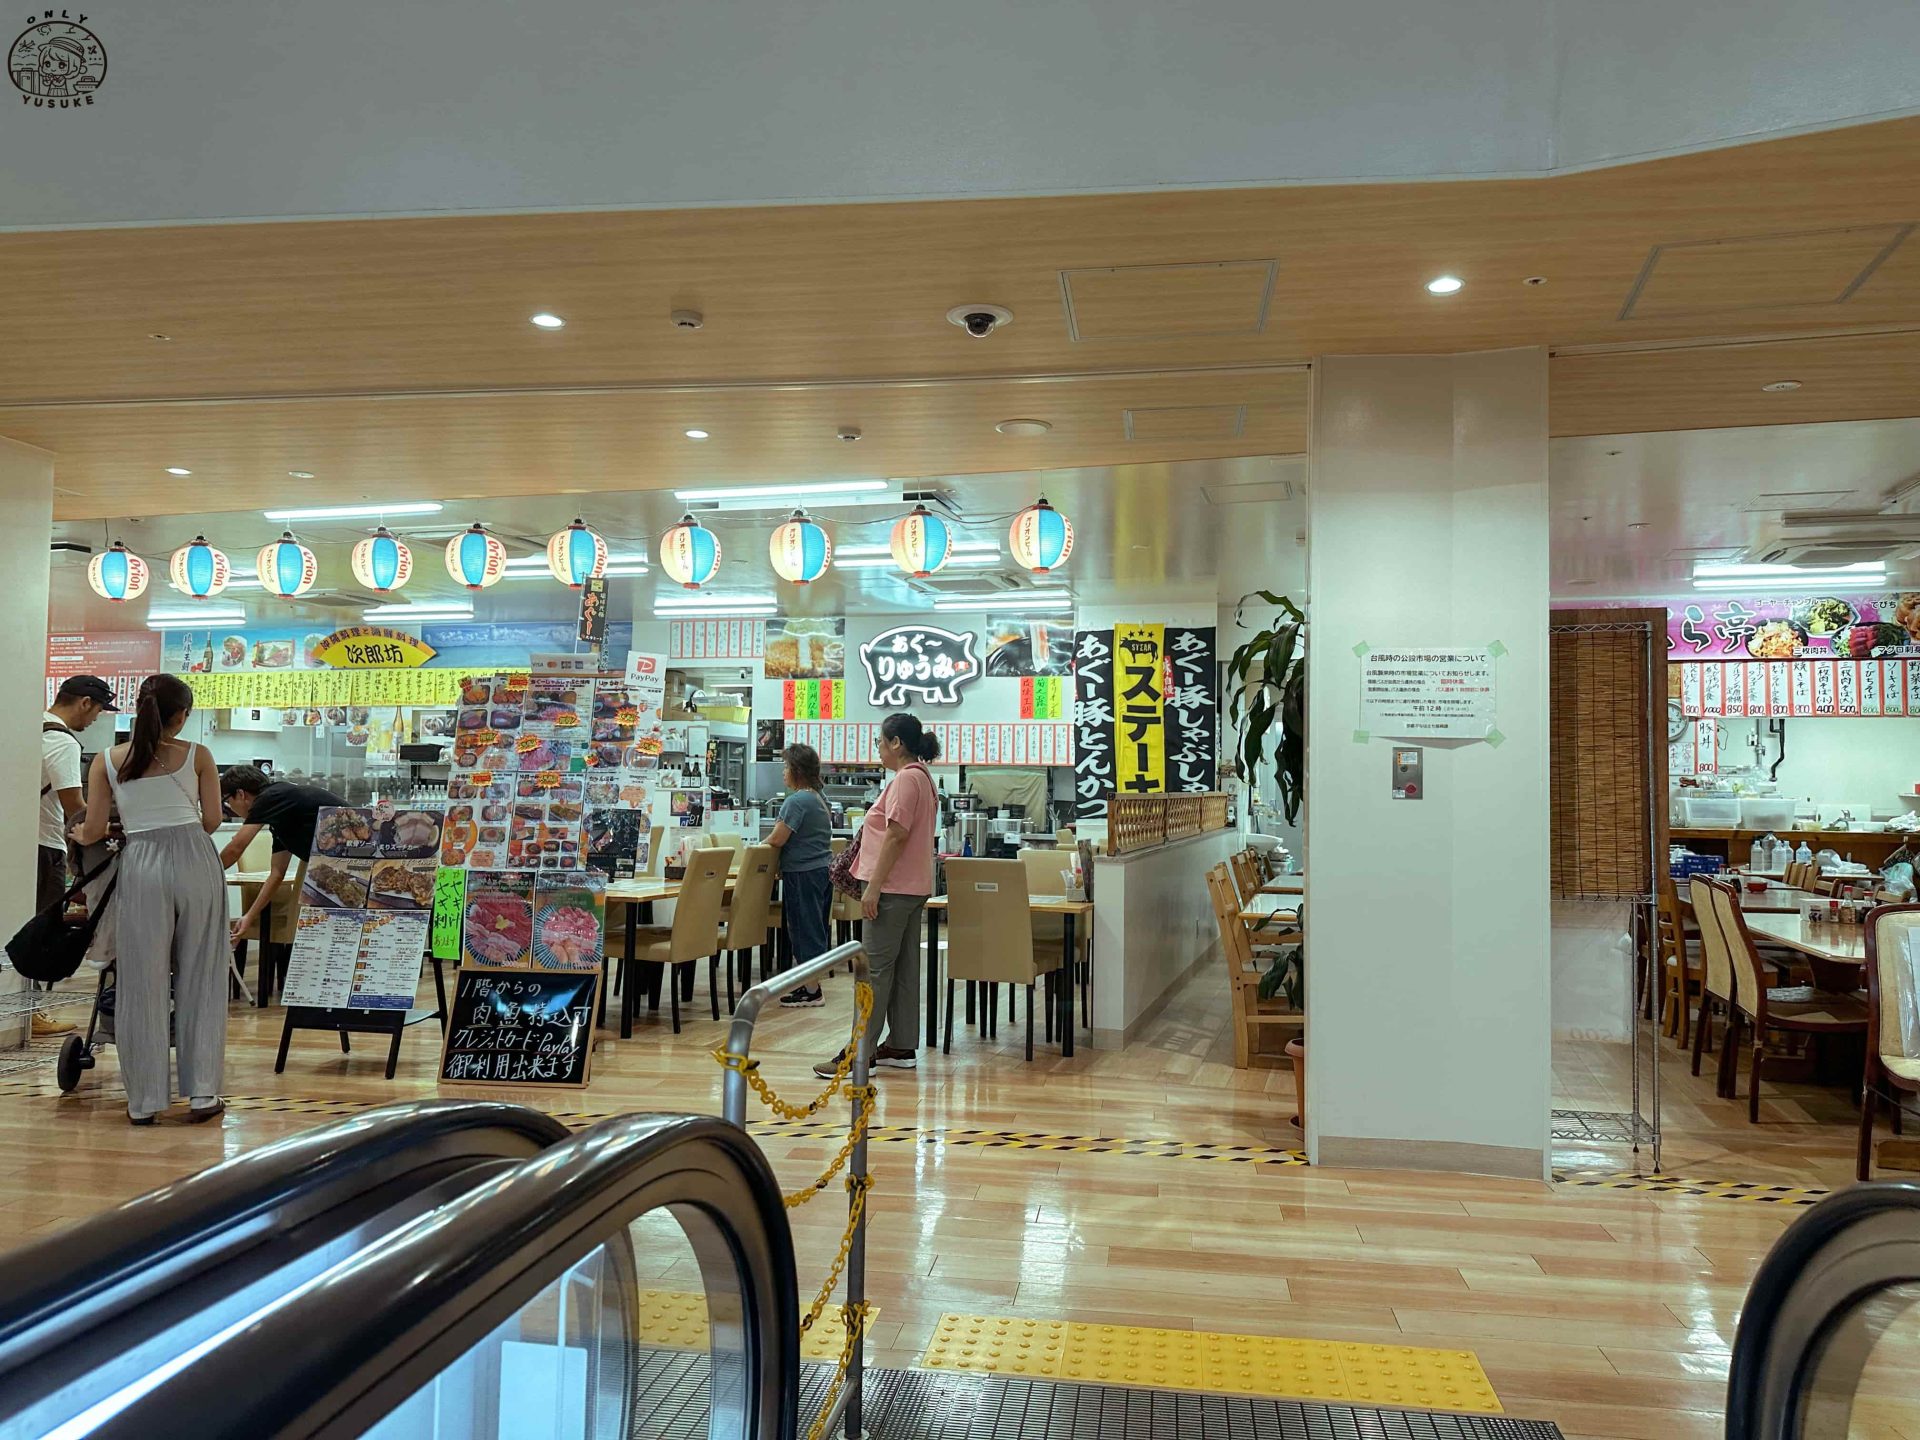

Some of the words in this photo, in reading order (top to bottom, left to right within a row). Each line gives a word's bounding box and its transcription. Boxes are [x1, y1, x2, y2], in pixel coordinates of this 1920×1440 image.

[397, 544, 410, 579] Orion
[486, 540, 502, 576] Orion
[128, 558, 144, 591] Orion
[1755, 599, 1829, 608] ゴーヤーチャンプルー
[1871, 601, 1897, 609] てびち
[1668, 602, 1756, 653] ら亭
[345, 644, 403, 664] 次郎坊
[1793, 646, 1828, 655] 三枚肉丼
[1370, 654, 1486, 662] 台風時の公設市場の営業について
[879, 653, 955, 682] りゅうみ
[631, 673, 659, 683] PayPay
[1794, 662, 1808, 696] 焼きそば
[1864, 662, 1876, 700] てびちそば
[1886, 662, 1900, 699] ソーキそば
[1686, 705, 1699, 714] 800
[1726, 704, 1742, 714] 850
[1750, 704, 1764, 714] 800
[1772, 704, 1788, 714] 800
[1795, 704, 1810, 714] 800
[1816, 705, 1834, 713] 400
[1700, 722, 1714, 749] 豚丼
[1699, 764, 1713, 772] 800
[433, 935, 457, 947] あります
[461, 978, 542, 998] 1階からの
[446, 1053, 577, 1079] 御利用出来ます
